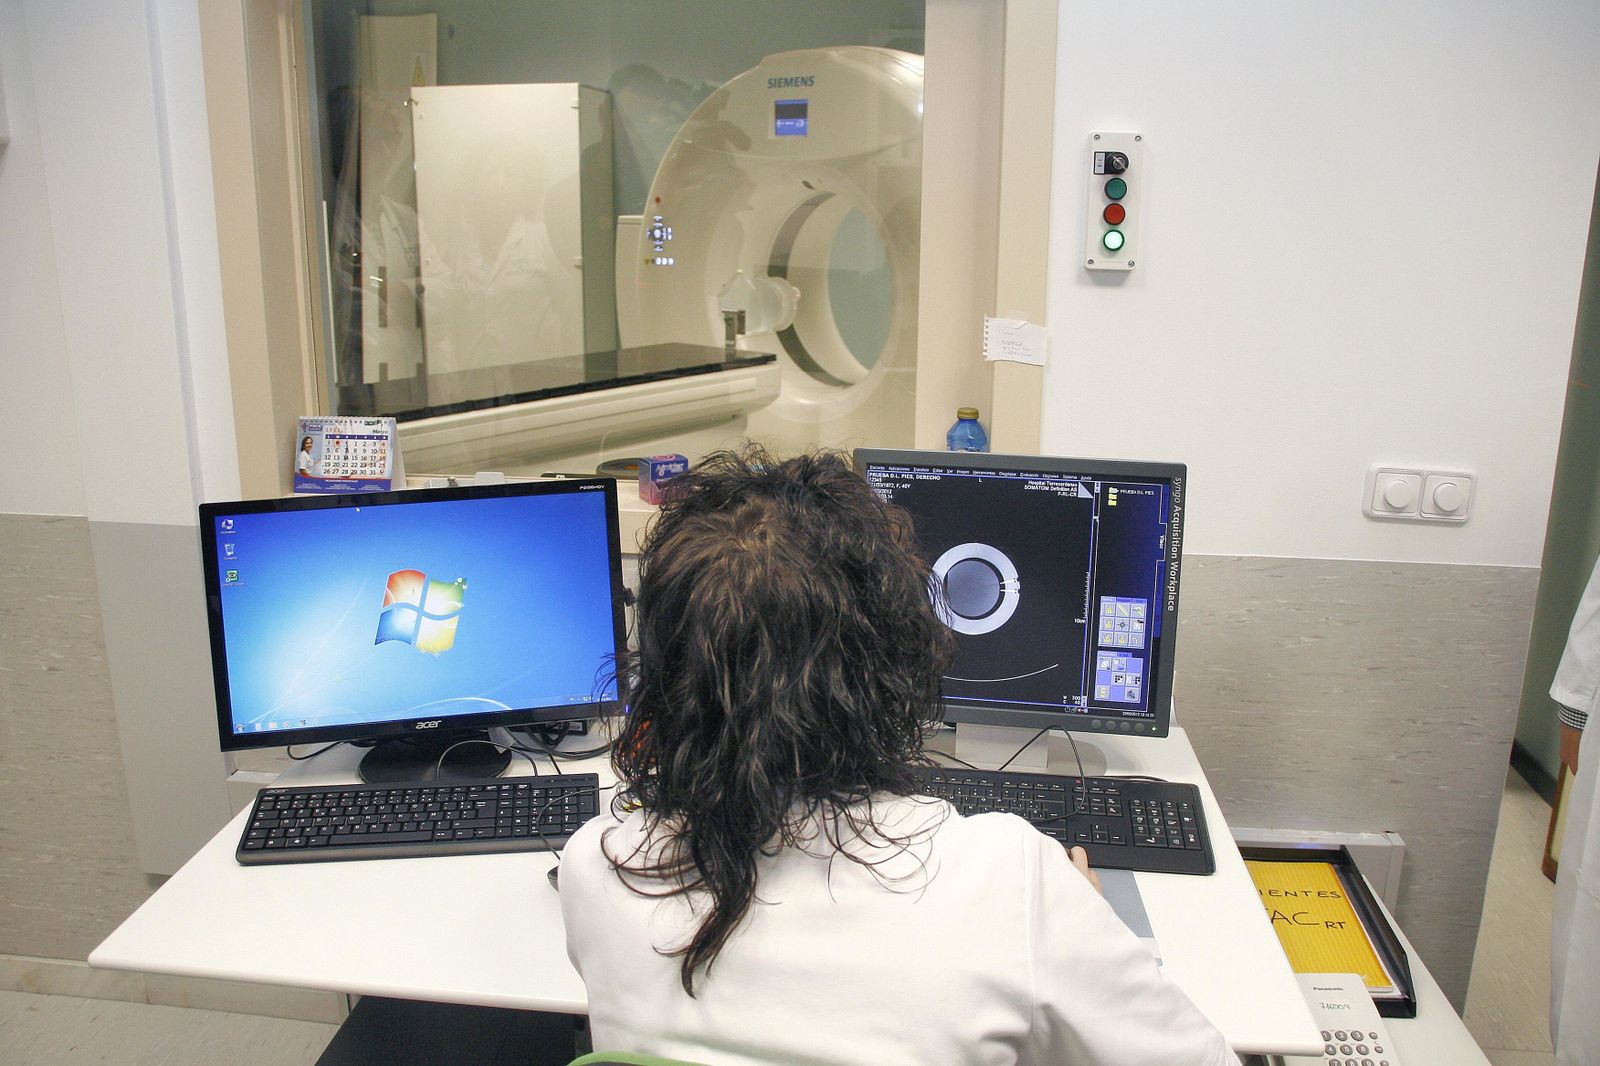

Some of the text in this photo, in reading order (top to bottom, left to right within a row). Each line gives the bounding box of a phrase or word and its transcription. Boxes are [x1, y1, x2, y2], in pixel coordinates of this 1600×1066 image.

[768, 76, 815, 88] SIEMENS
[1170, 505, 1182, 559] Acquisition
[1167, 561, 1179, 612] Workplace
[416, 720, 442, 730] acer
[1266, 908, 1346, 929] AC RT
